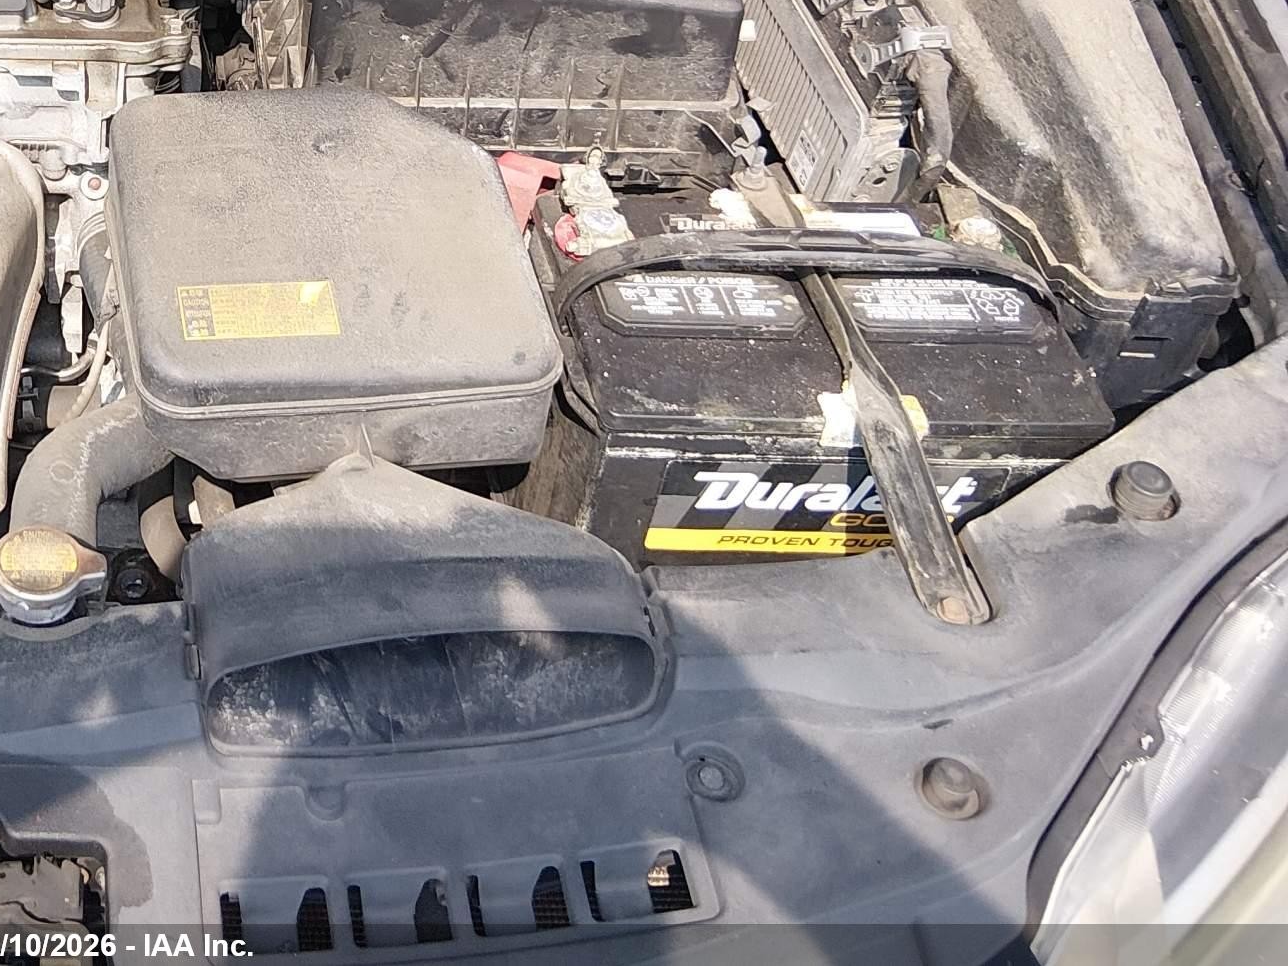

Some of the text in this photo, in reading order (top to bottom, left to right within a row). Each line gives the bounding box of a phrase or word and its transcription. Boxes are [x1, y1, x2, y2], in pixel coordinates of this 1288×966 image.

[670, 217, 756, 230] Dura
[645, 276, 697, 284] DANGER
[693, 471, 978, 511] Duralt
[718, 536, 895, 548] PROVEN TOUG
